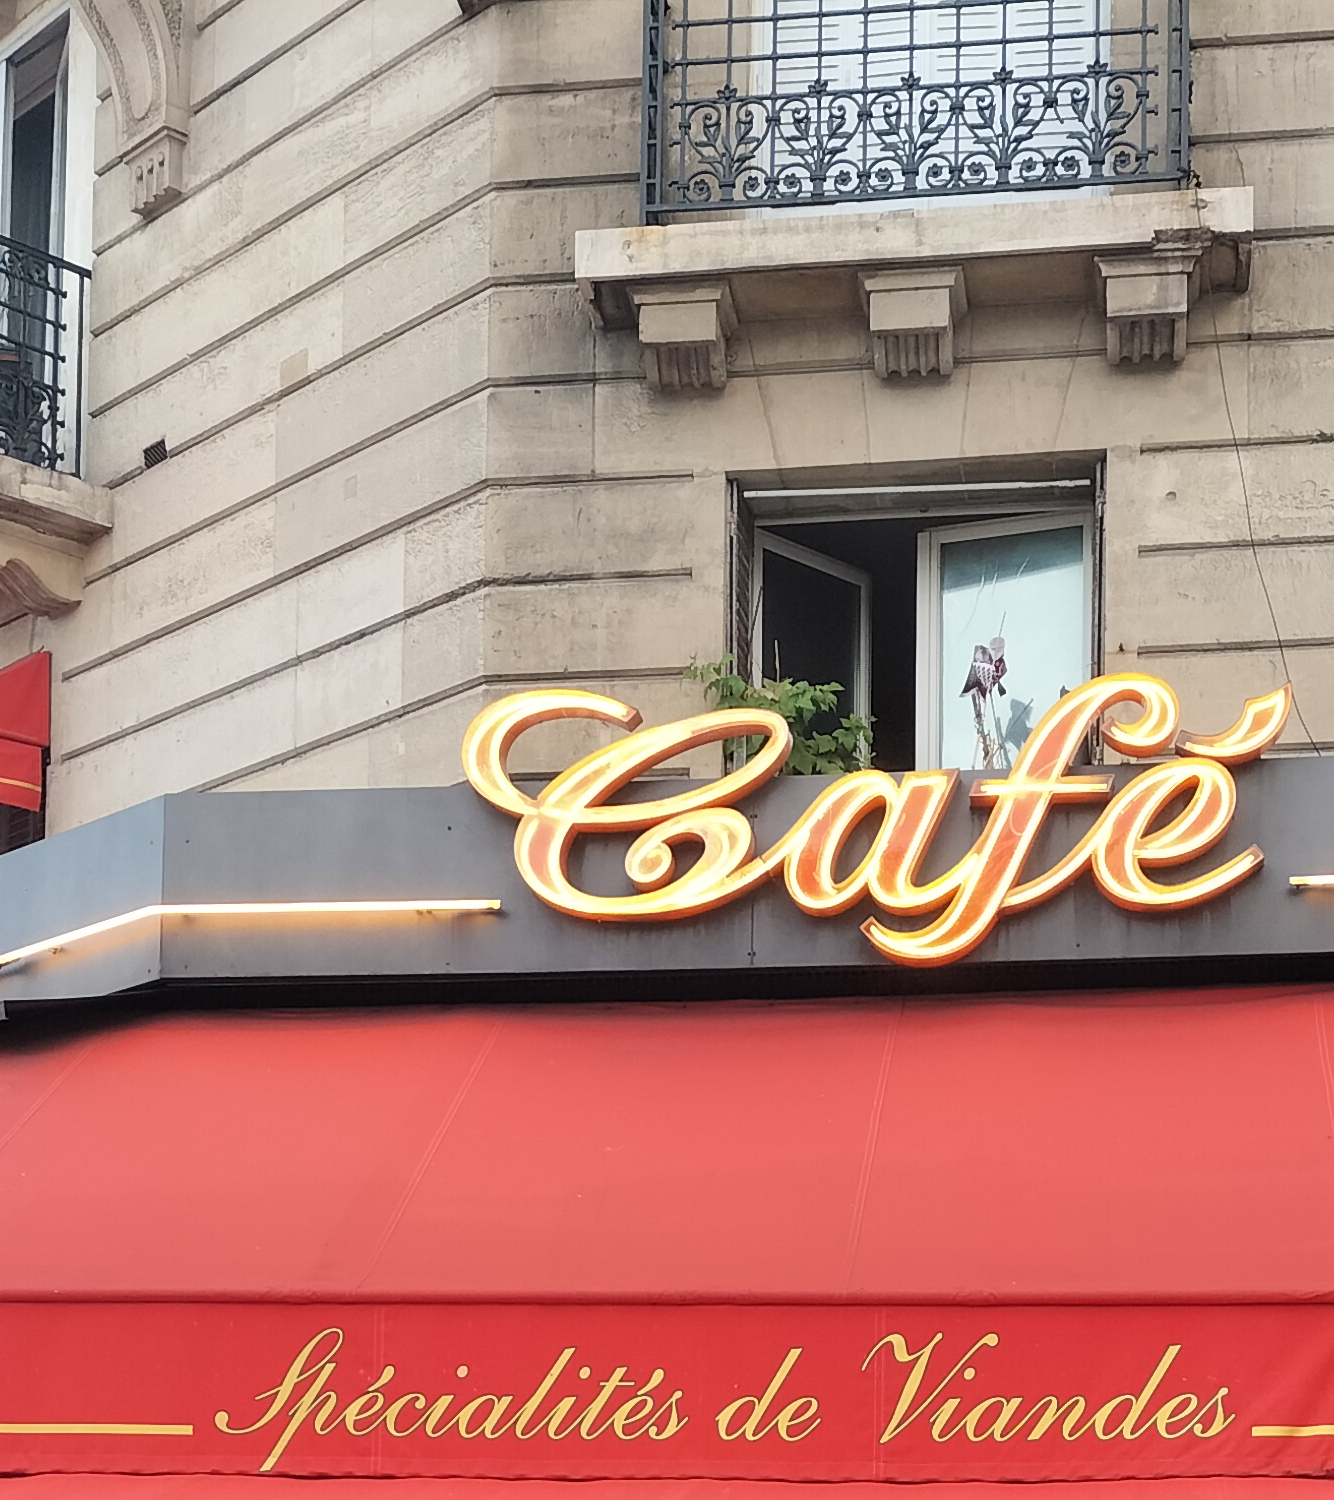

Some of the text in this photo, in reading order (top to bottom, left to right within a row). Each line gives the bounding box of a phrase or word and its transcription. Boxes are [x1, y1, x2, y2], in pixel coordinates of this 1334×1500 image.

[462, 671, 1292, 968] Café
[214, 1326, 1236, 1473] Spécialités de Viandes
